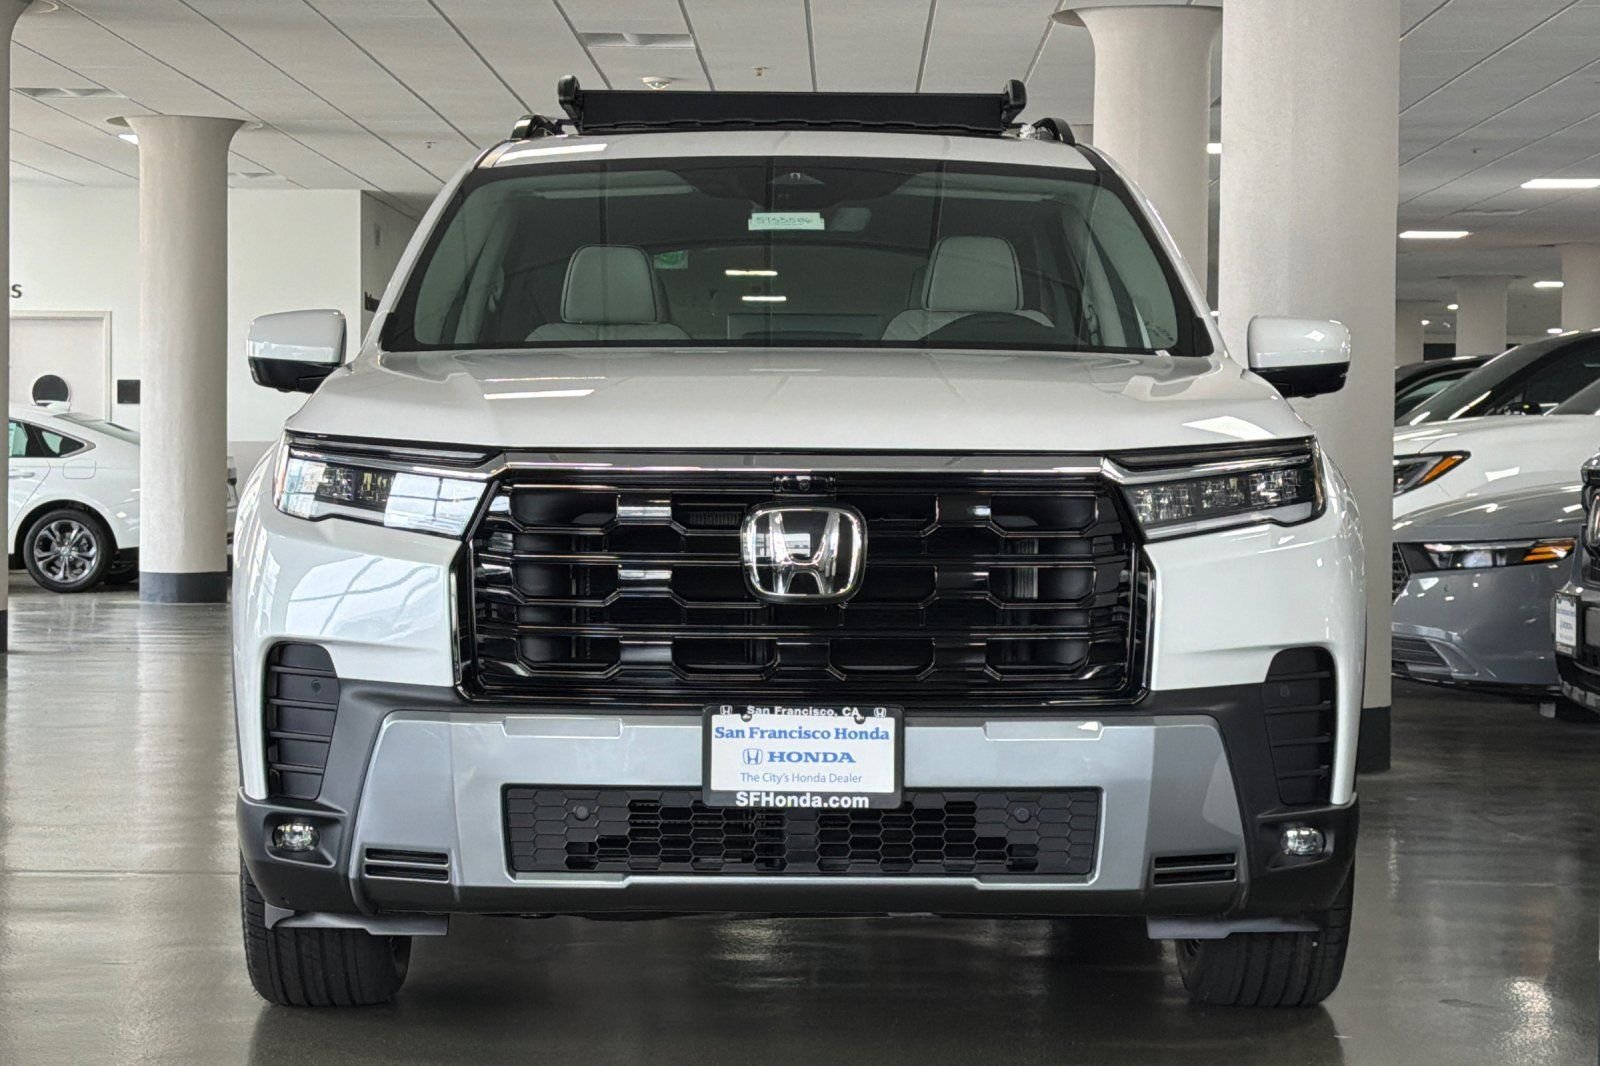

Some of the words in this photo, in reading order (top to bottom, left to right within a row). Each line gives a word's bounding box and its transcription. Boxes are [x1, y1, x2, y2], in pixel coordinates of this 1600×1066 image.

[746, 705, 769, 716] San
[774, 706, 837, 717] Francisco,
[842, 707, 861, 717] CA
[714, 726, 745, 739] San
[749, 726, 831, 740] Francisco
[834, 727, 890, 740] Honda
[767, 751, 856, 763] HONDA
[741, 772, 760, 783] The
[762, 772, 790, 785] City's
[792, 773, 826, 783] Honda
[829, 773, 863, 784] Dealer
[735, 791, 870, 809] SFHonda.com
